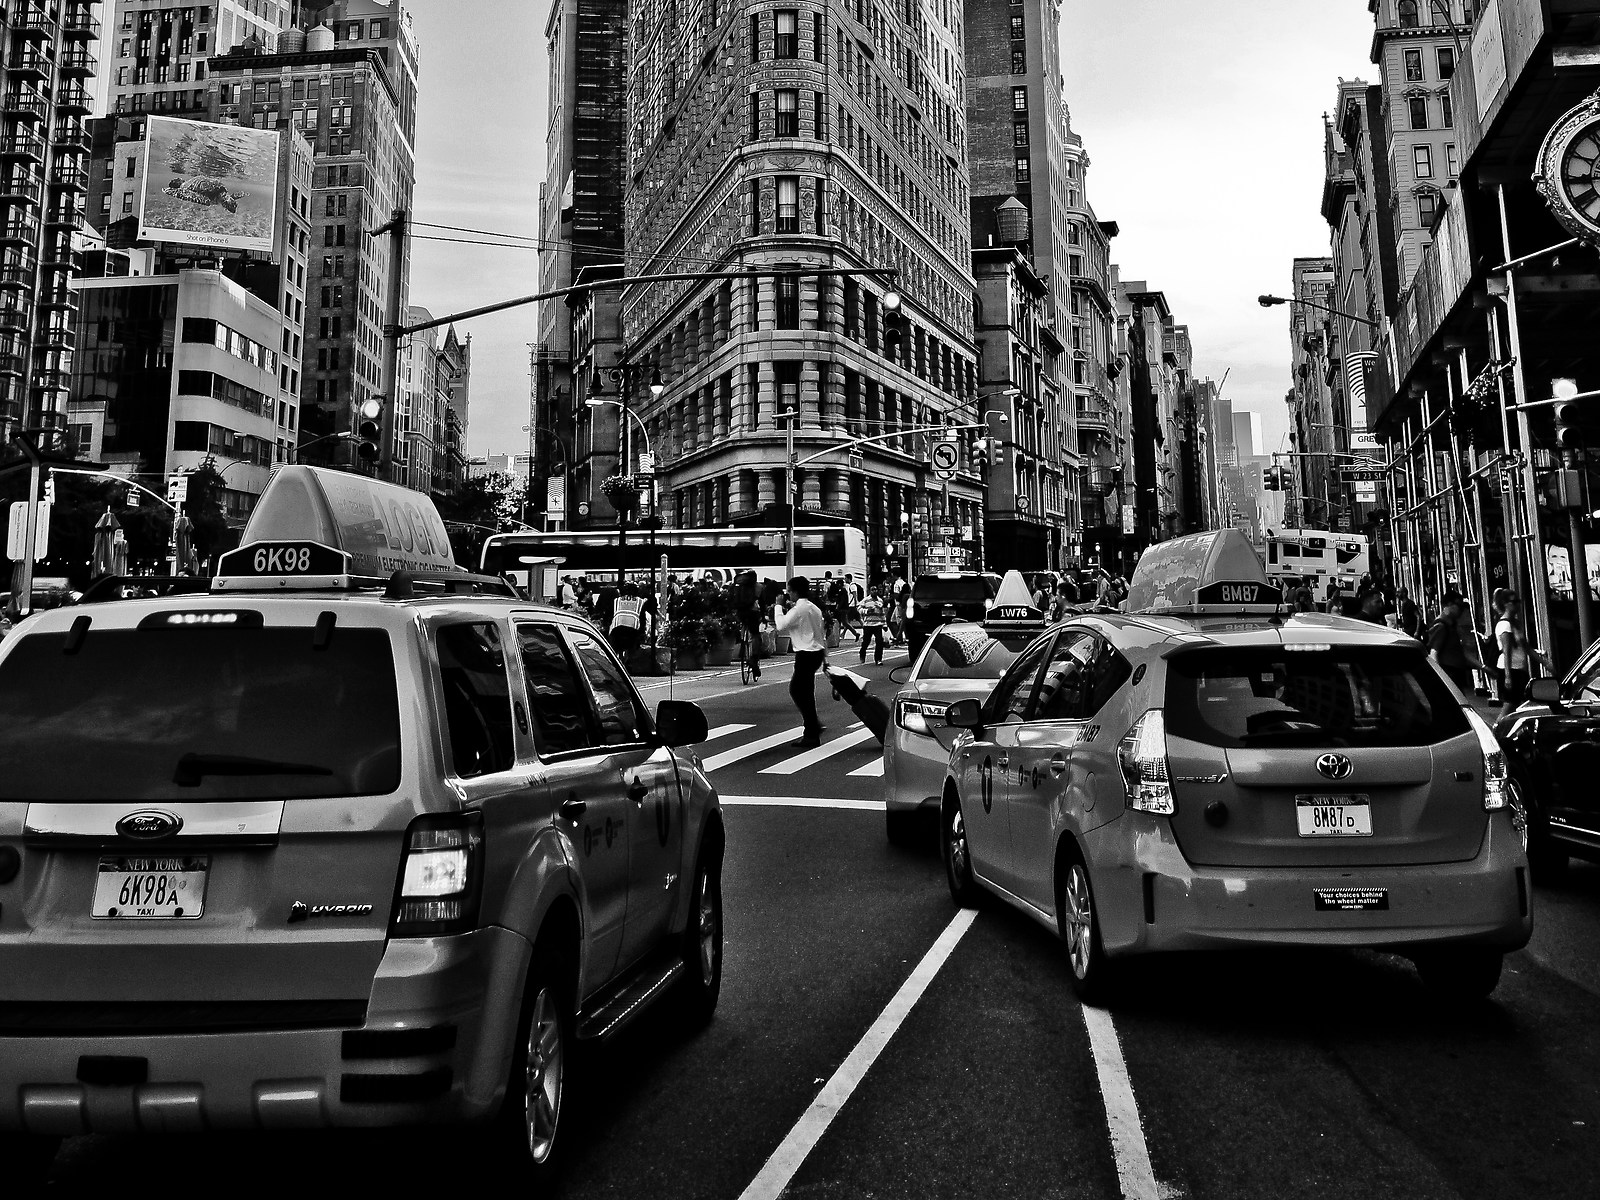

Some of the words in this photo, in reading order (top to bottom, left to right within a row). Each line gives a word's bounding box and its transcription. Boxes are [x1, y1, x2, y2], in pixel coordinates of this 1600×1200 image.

[186, 234, 200, 242] Shot
[1352, 472, 1360, 480] W
[1362, 472, 1372, 480] 23
[1374, 472, 1382, 480] St
[372, 494, 449, 559] LOGIC
[253, 547, 311, 572] 6K98
[1222, 585, 1259, 602] 8M87
[1000, 607, 1028, 618] 1W76
[1313, 797, 1330, 805] NEW
[1331, 797, 1352, 805] YORK
[1313, 806, 1344, 828] 8M87
[132, 816, 161, 831] Ford
[126, 859, 150, 871] NEW
[153, 859, 182, 871] YORK
[136, 908, 156, 916] TAXI
[310, 904, 373, 916] HYBRID
